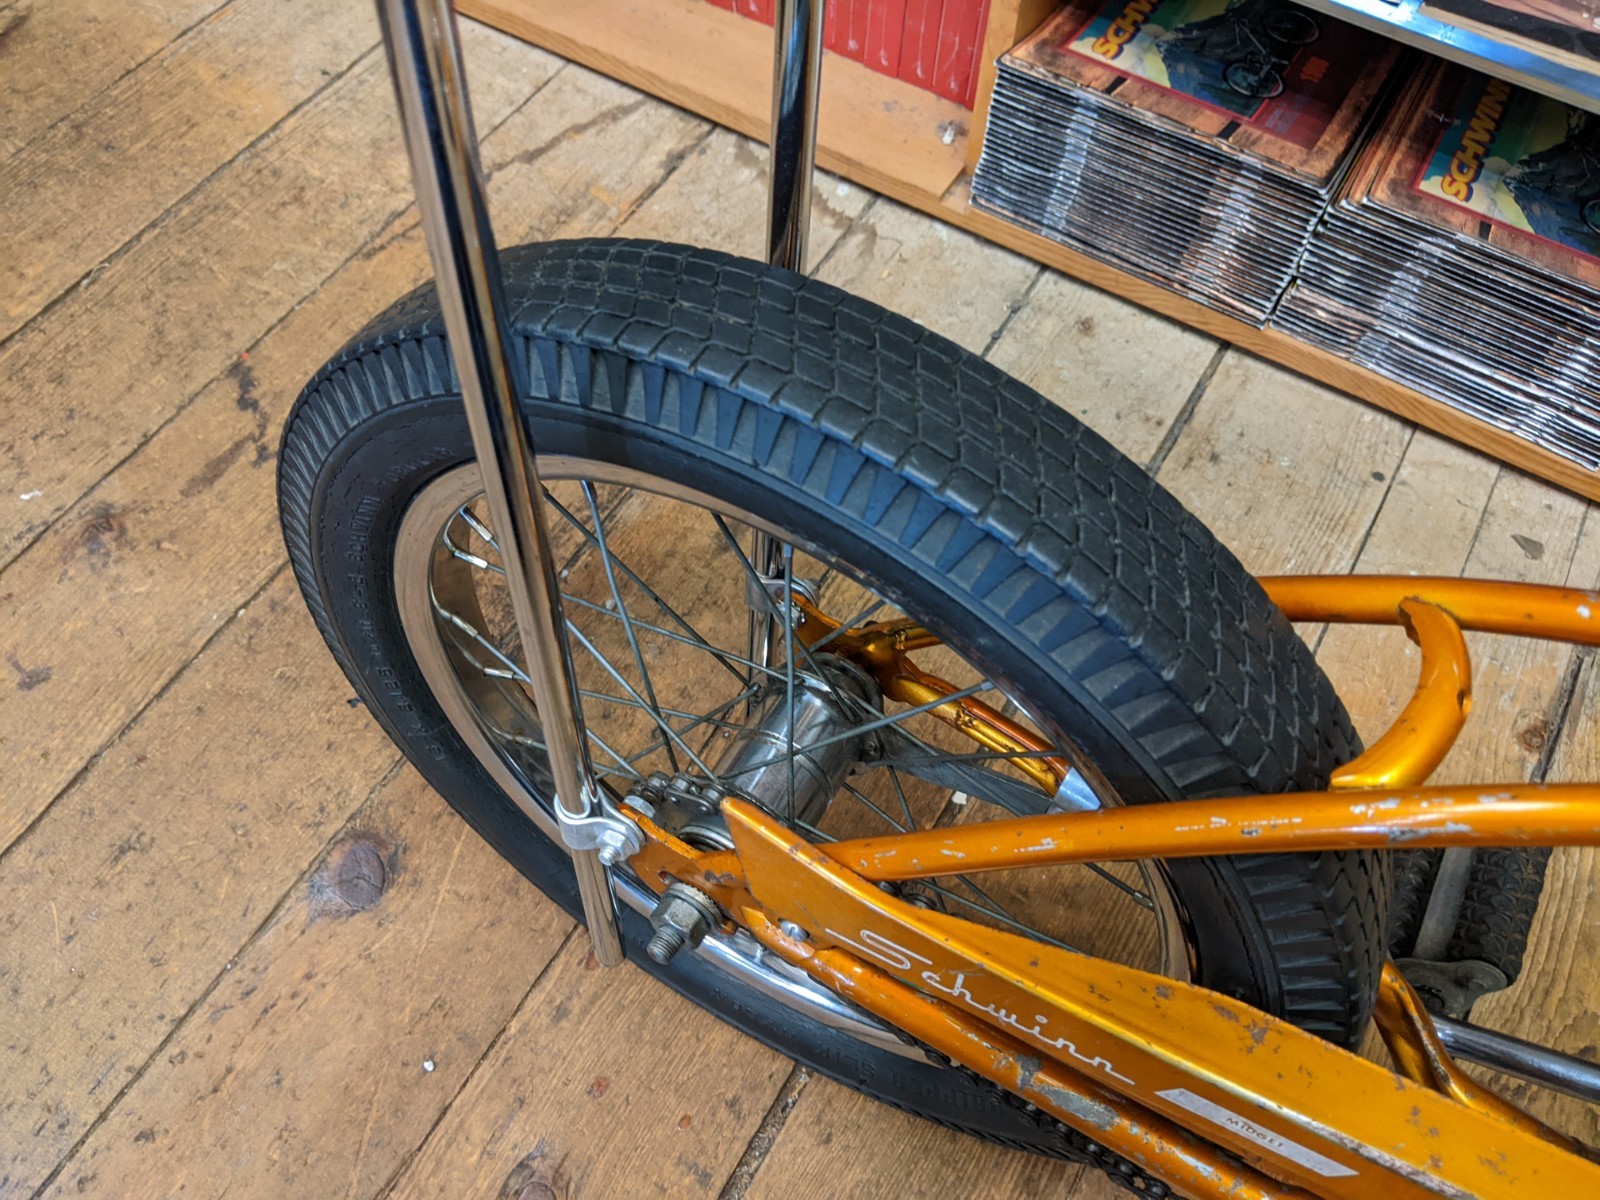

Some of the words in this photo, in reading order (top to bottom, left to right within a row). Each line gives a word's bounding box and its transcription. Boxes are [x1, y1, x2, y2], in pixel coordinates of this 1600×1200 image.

[348, 492, 382, 562] SCHWINN
[825, 928, 1136, 1086] Schwinn
[1226, 1116, 1287, 1150] MIDGET
